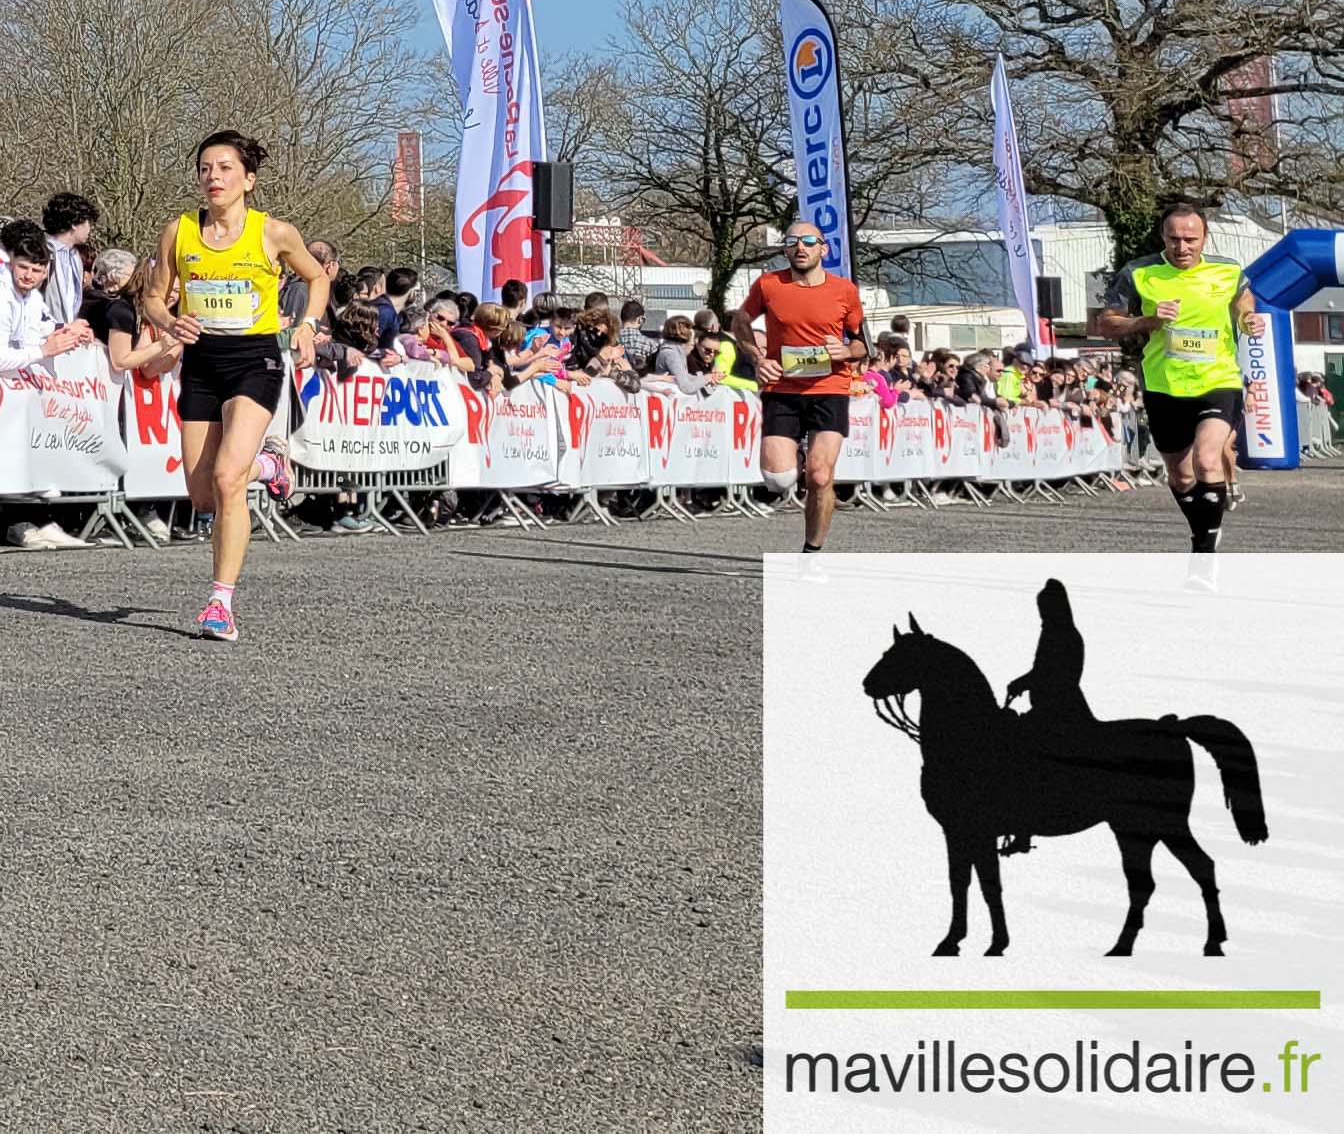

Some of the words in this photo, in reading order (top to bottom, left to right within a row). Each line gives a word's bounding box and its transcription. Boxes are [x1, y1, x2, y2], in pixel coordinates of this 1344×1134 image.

[203, 297, 233, 309] 1016
[320, 372, 449, 427] INTERSPORT
[1248, 334, 1272, 431] INTERSPOR
[322, 438, 336, 453] LA
[341, 439, 375, 455] ROCHE
[379, 441, 400, 455] SUR
[404, 440, 432, 454] YON
